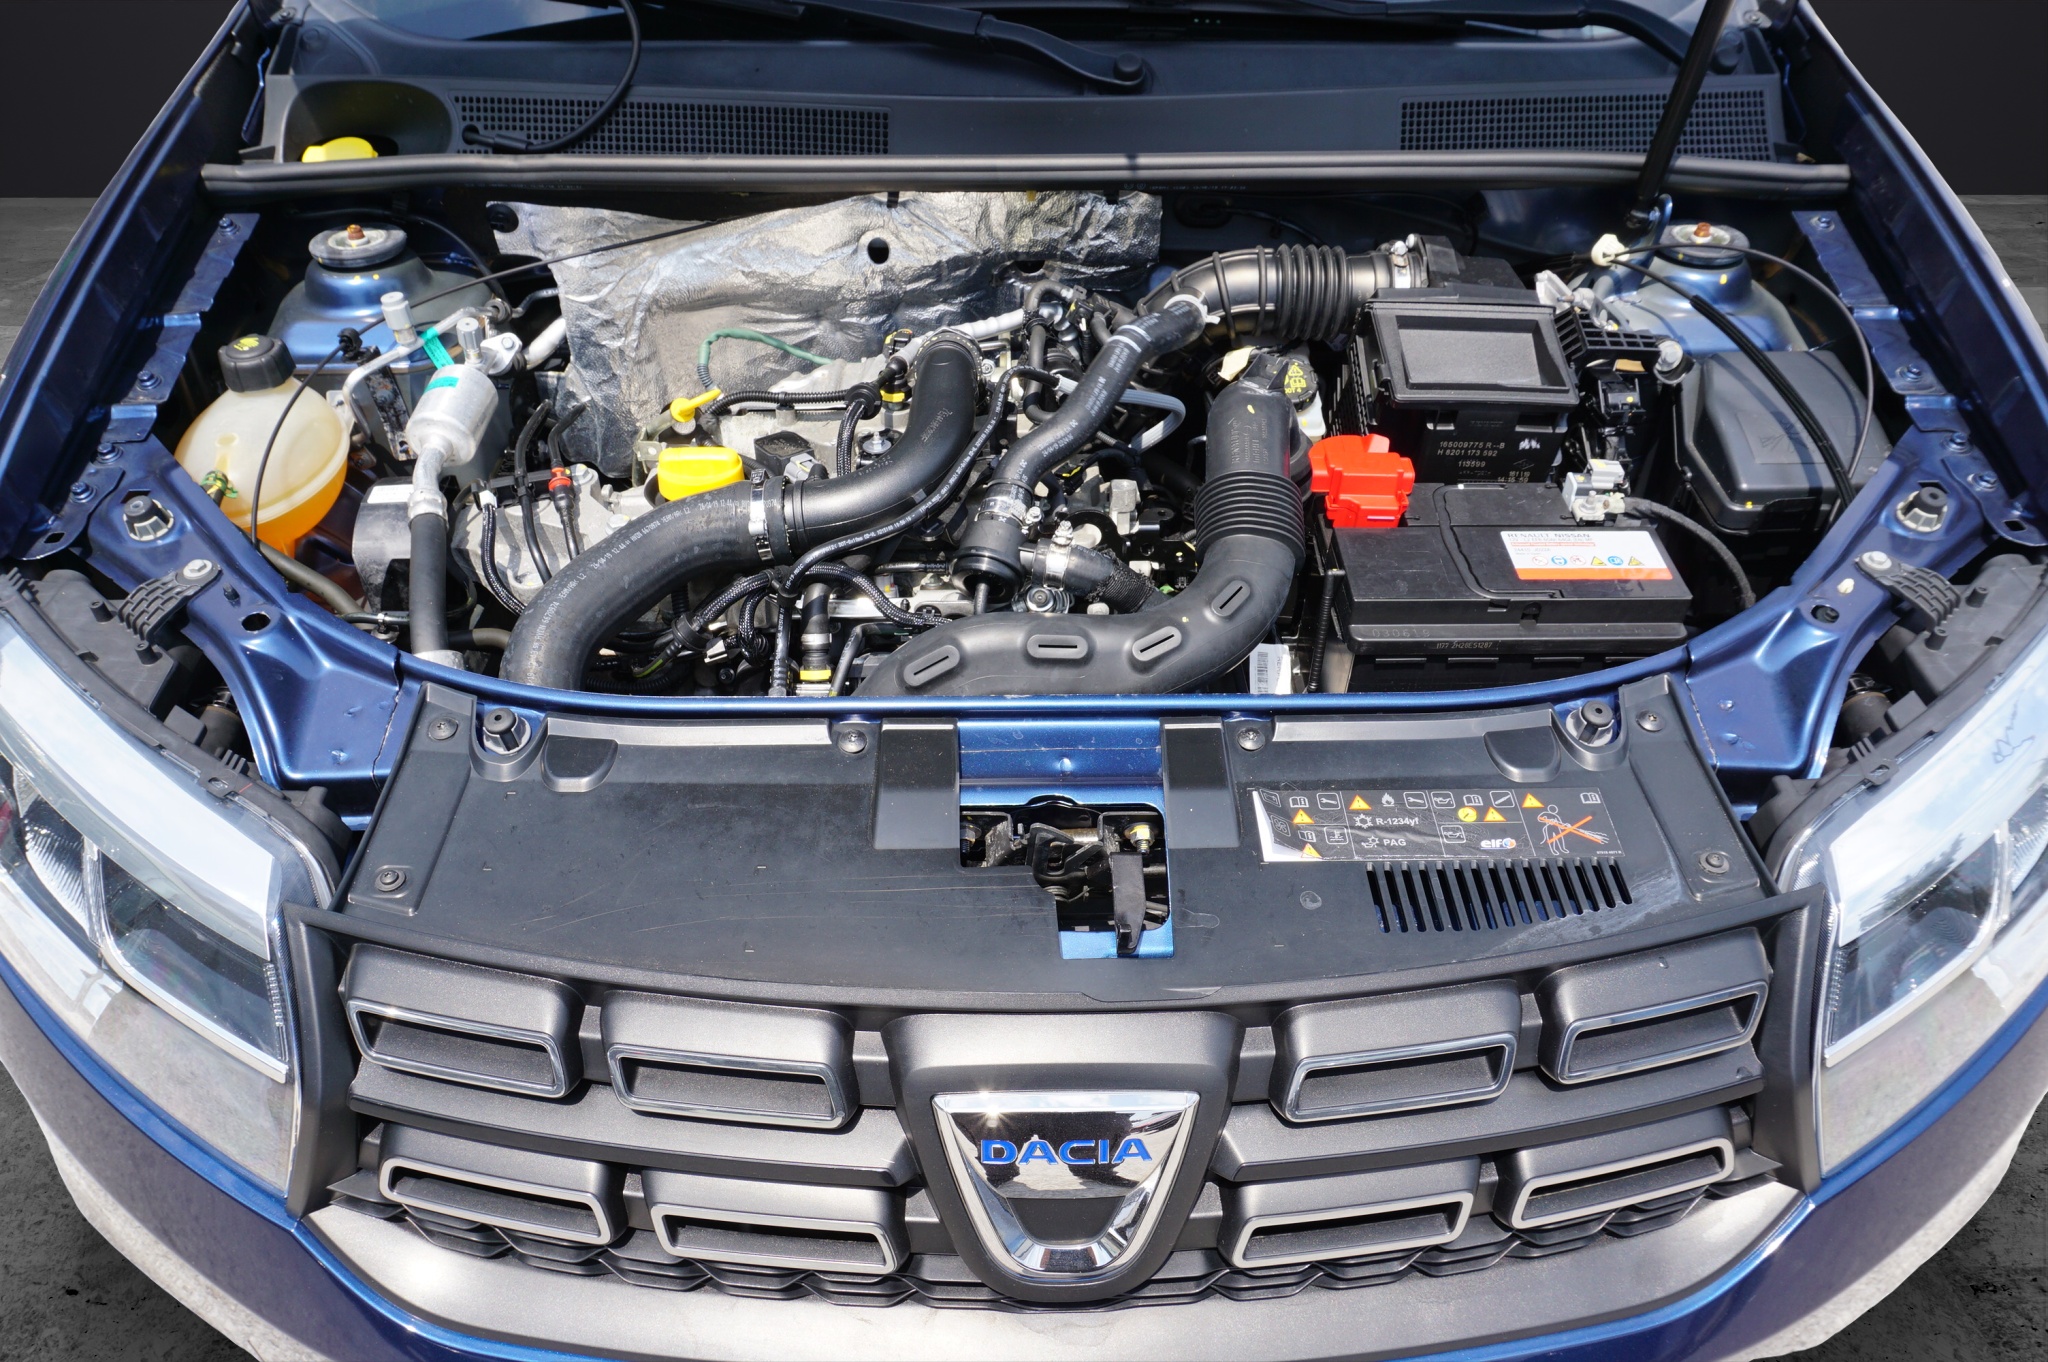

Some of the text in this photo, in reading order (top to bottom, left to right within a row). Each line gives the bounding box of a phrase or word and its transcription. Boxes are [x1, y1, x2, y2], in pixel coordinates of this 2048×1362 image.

[1376, 817, 1419, 827] R-1234yf
[1383, 838, 1407, 847] PAG
[1480, 838, 1504, 849] elf
[980, 1138, 1152, 1165] DACIA
